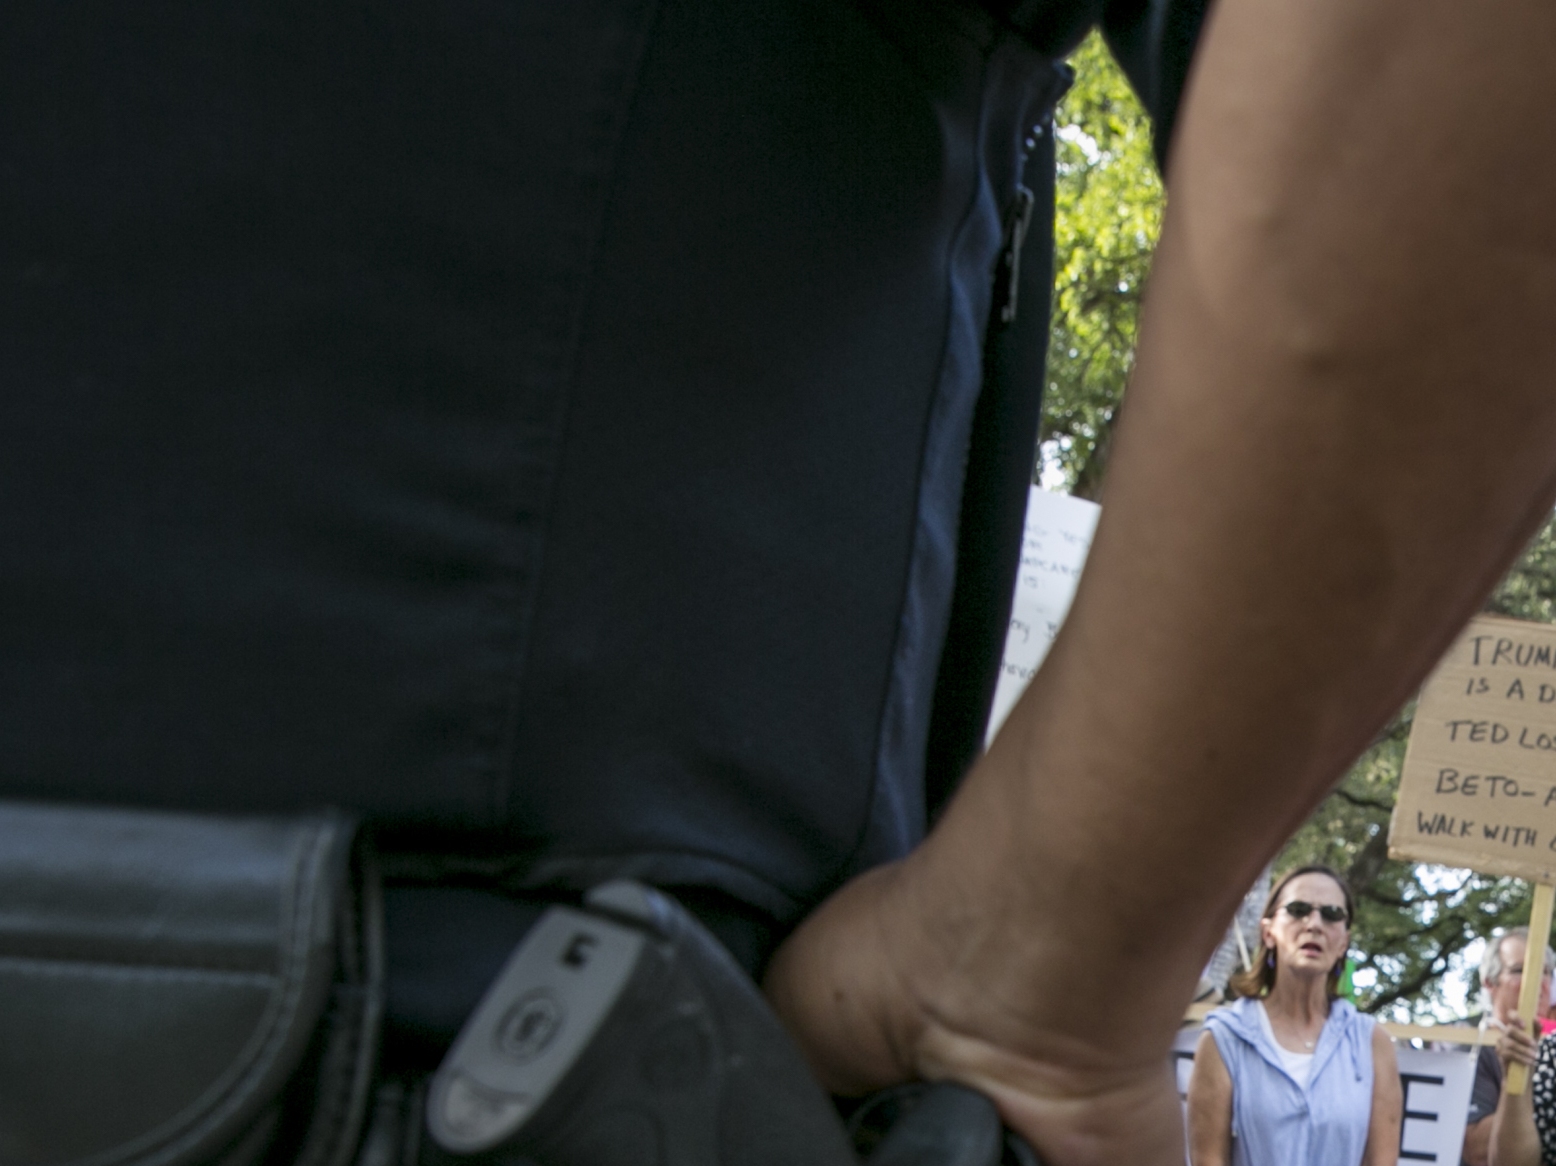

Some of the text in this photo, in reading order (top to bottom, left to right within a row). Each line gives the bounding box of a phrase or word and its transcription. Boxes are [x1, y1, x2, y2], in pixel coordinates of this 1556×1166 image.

[1466, 677, 1490, 695] IS
[1506, 678, 1525, 701] A
[1446, 719, 1509, 743] TED
[1416, 811, 1473, 838] WALK
[1482, 825, 1538, 846] WITH
